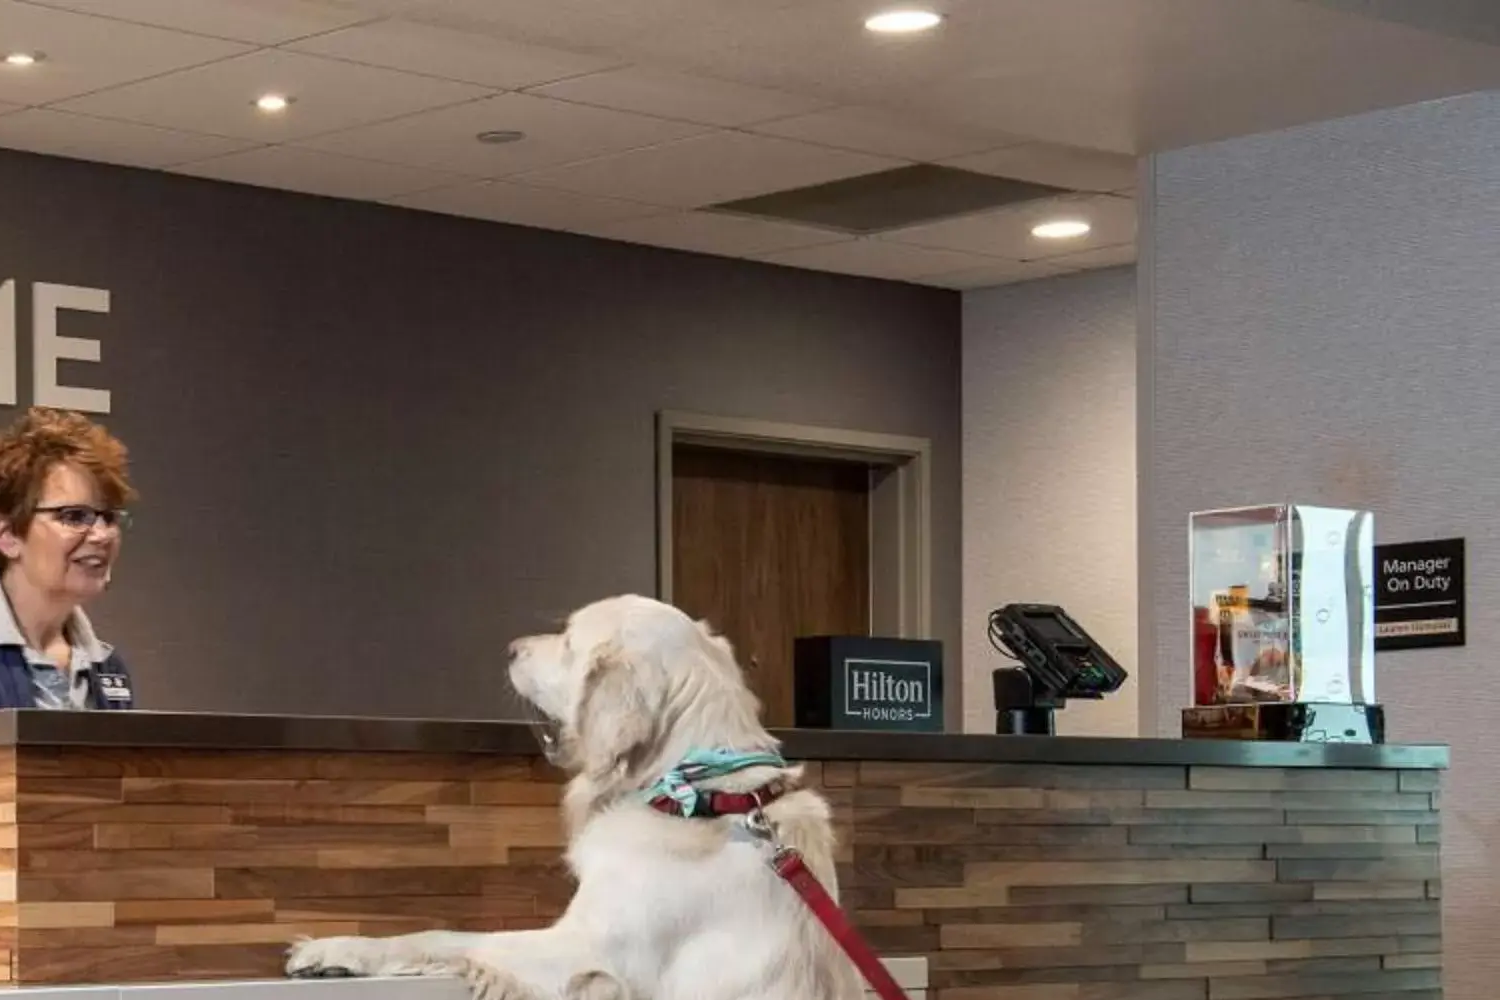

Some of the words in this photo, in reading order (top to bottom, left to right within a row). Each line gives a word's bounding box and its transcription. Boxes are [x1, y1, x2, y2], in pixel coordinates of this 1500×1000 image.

[1383, 556, 1452, 575] Manager
[1387, 577, 1410, 592] On
[1414, 575, 1452, 591] Duty
[851, 669, 924, 702] Hilton
[862, 707, 915, 721] HONORS
